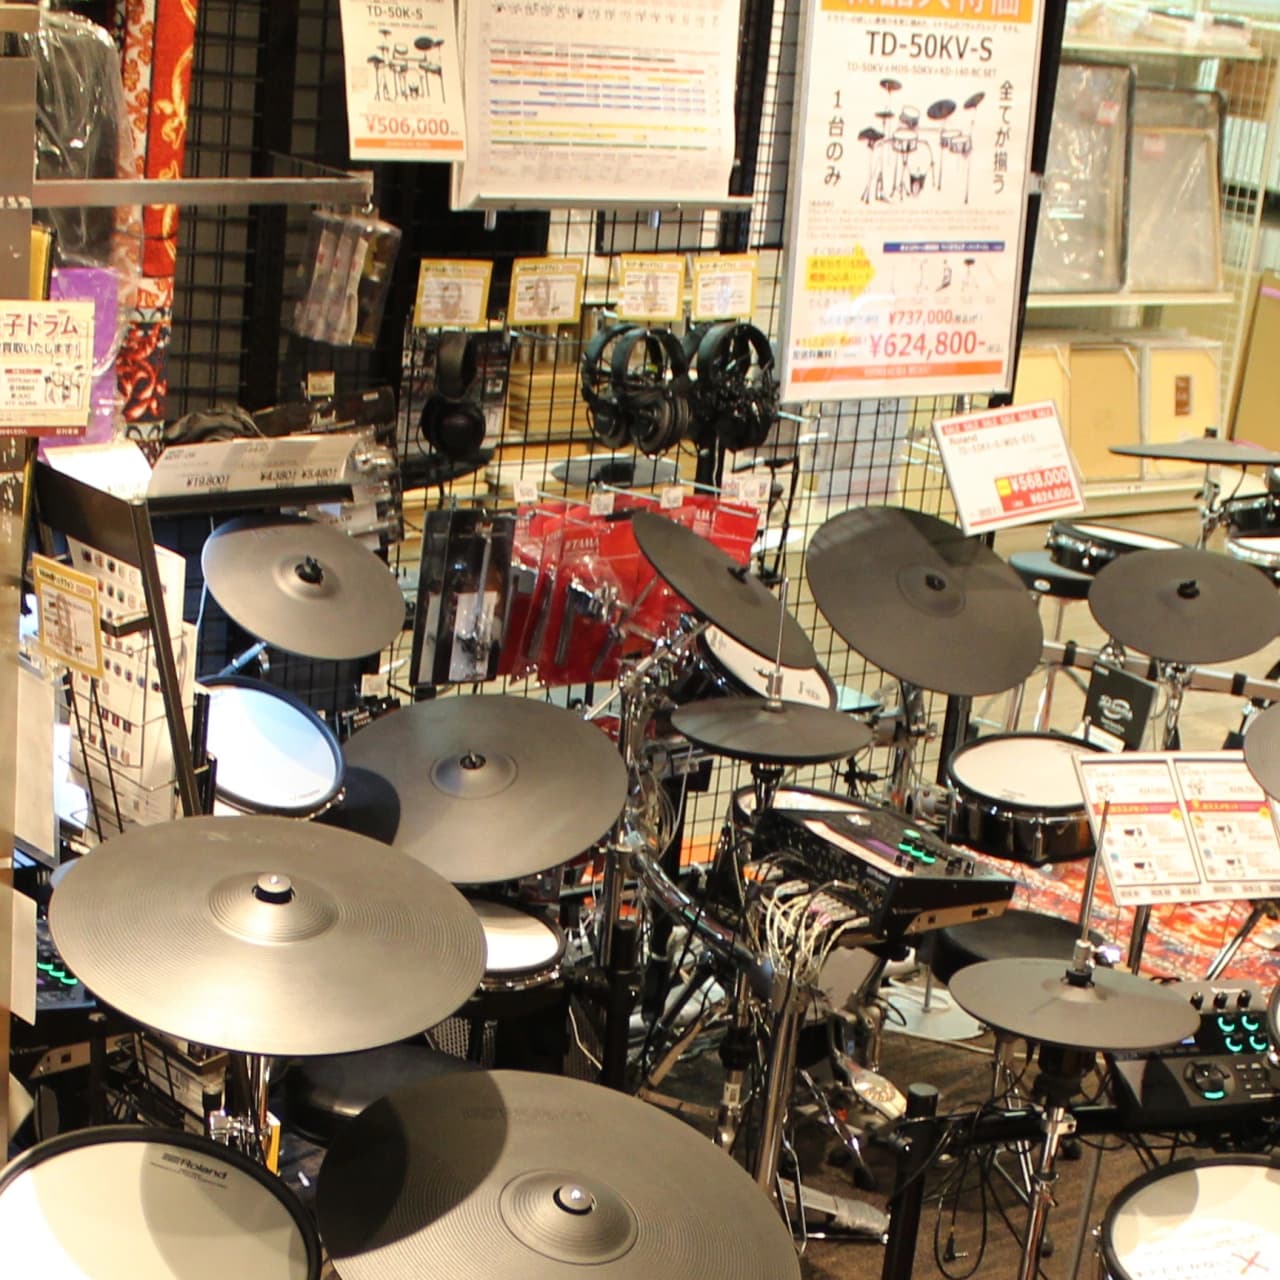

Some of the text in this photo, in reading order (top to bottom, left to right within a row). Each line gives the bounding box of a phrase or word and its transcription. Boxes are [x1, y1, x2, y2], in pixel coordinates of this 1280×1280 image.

[367, 5, 423, 20] TD-50K-S
[866, 30, 993, 62] TD-50KV-S
[365, 117, 449, 136] ¥506,000
[992, 80, 1014, 194] 全てが揃う
[823, 89, 845, 187] 1台のみ
[888, 310, 953, 325] ¥737,000
[180, 1158, 228, 1180] Roland
